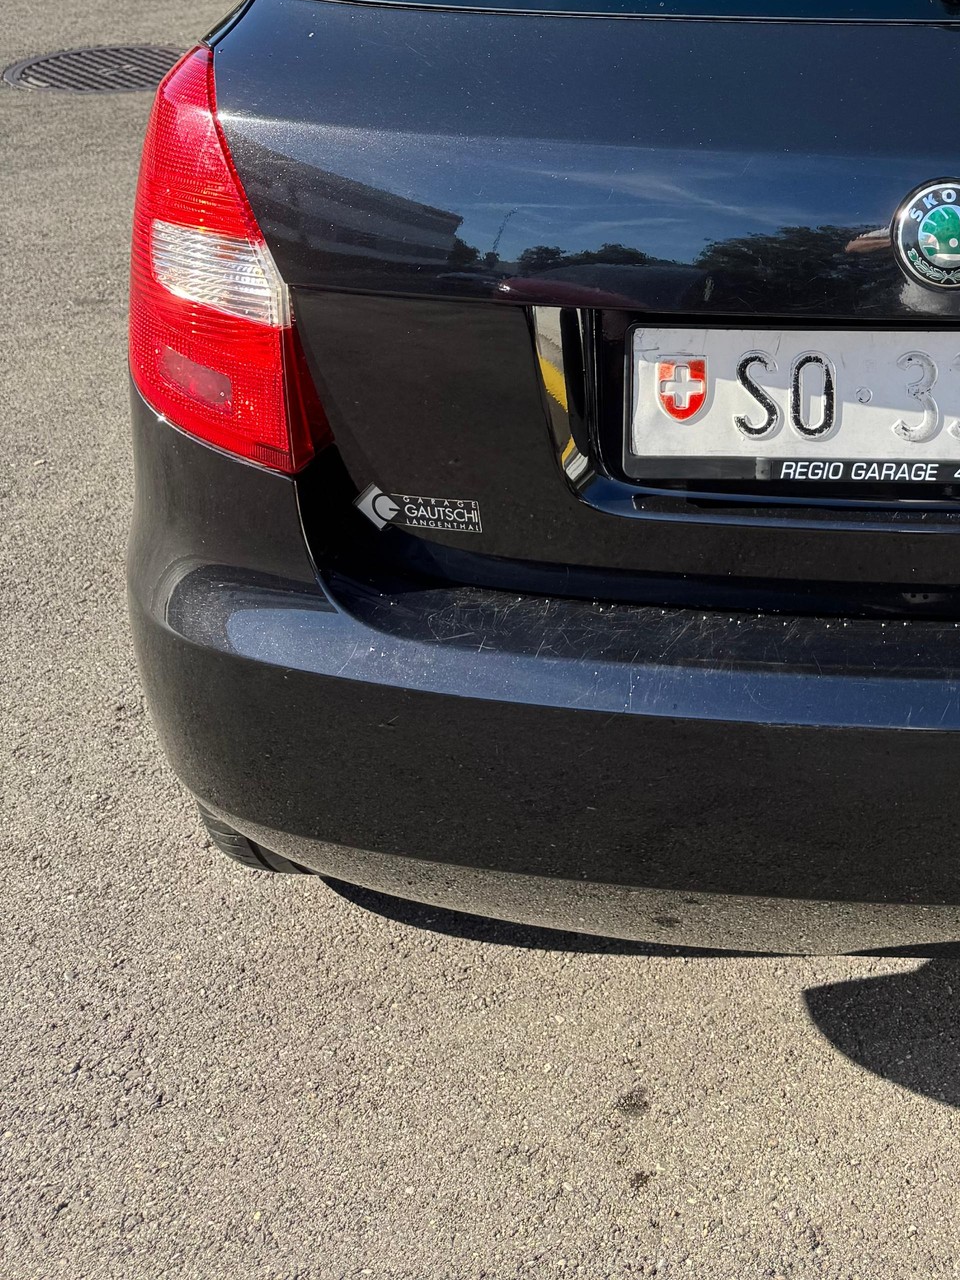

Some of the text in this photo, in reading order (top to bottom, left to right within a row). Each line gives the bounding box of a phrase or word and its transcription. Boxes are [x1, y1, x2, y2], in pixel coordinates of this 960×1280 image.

[733, 349, 837, 441] SO
[780, 461, 844, 480] REGIO
[851, 462, 939, 481] GARAGE
[403, 496, 477, 509] GARAGE
[404, 504, 479, 523] GAUTSCHI
[406, 518, 480, 531] LANGENTHAL
